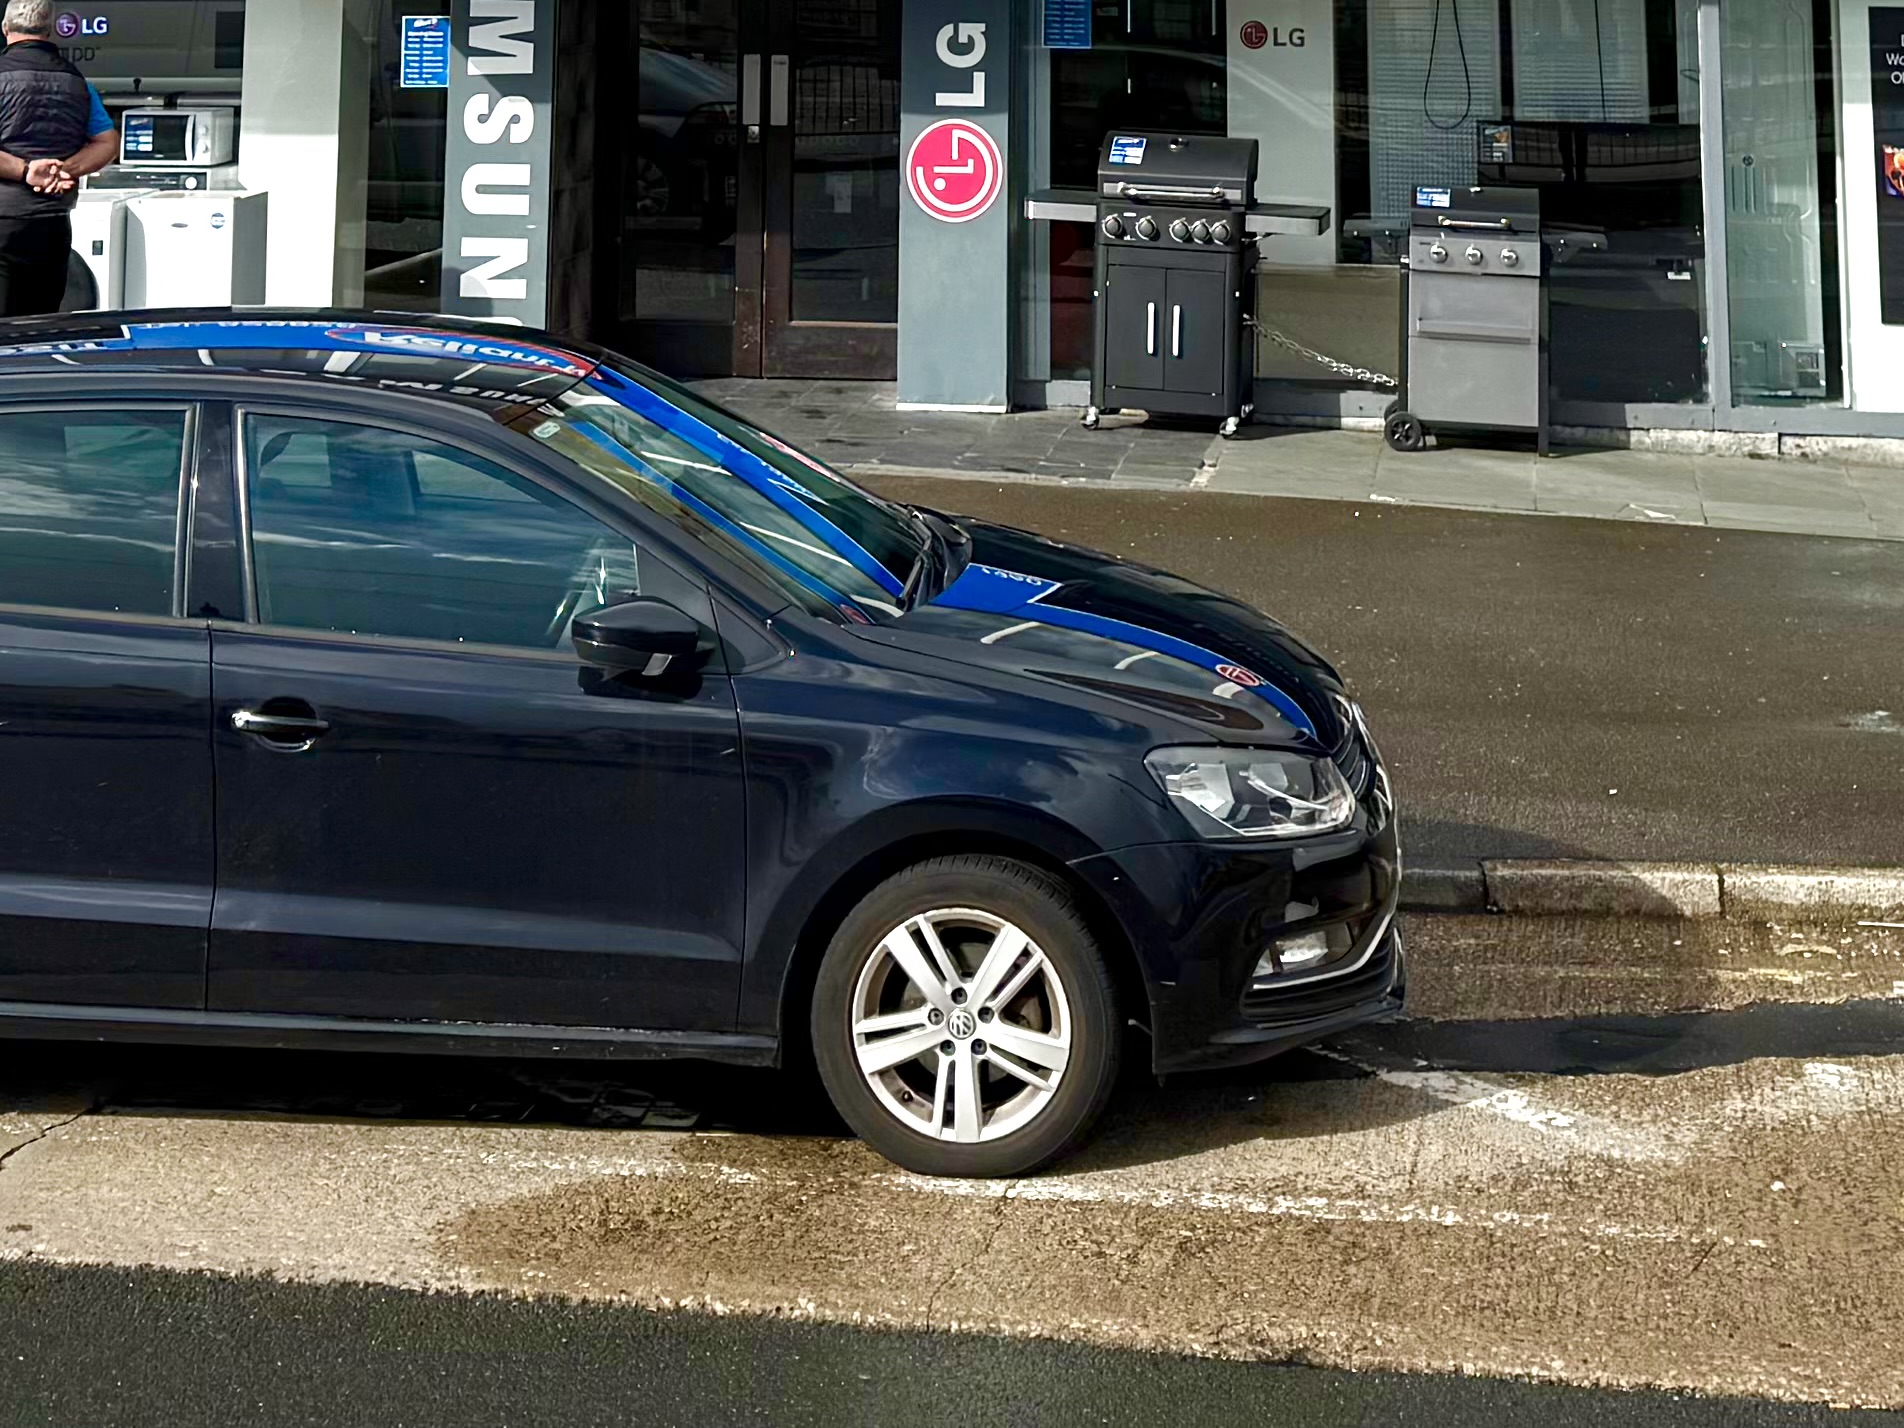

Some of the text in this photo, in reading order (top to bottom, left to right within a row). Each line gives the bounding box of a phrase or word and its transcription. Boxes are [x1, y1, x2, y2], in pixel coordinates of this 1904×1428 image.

[82, 15, 109, 34] LG
[1273, 26, 1305, 48] LG
[935, 21, 987, 108] LG
